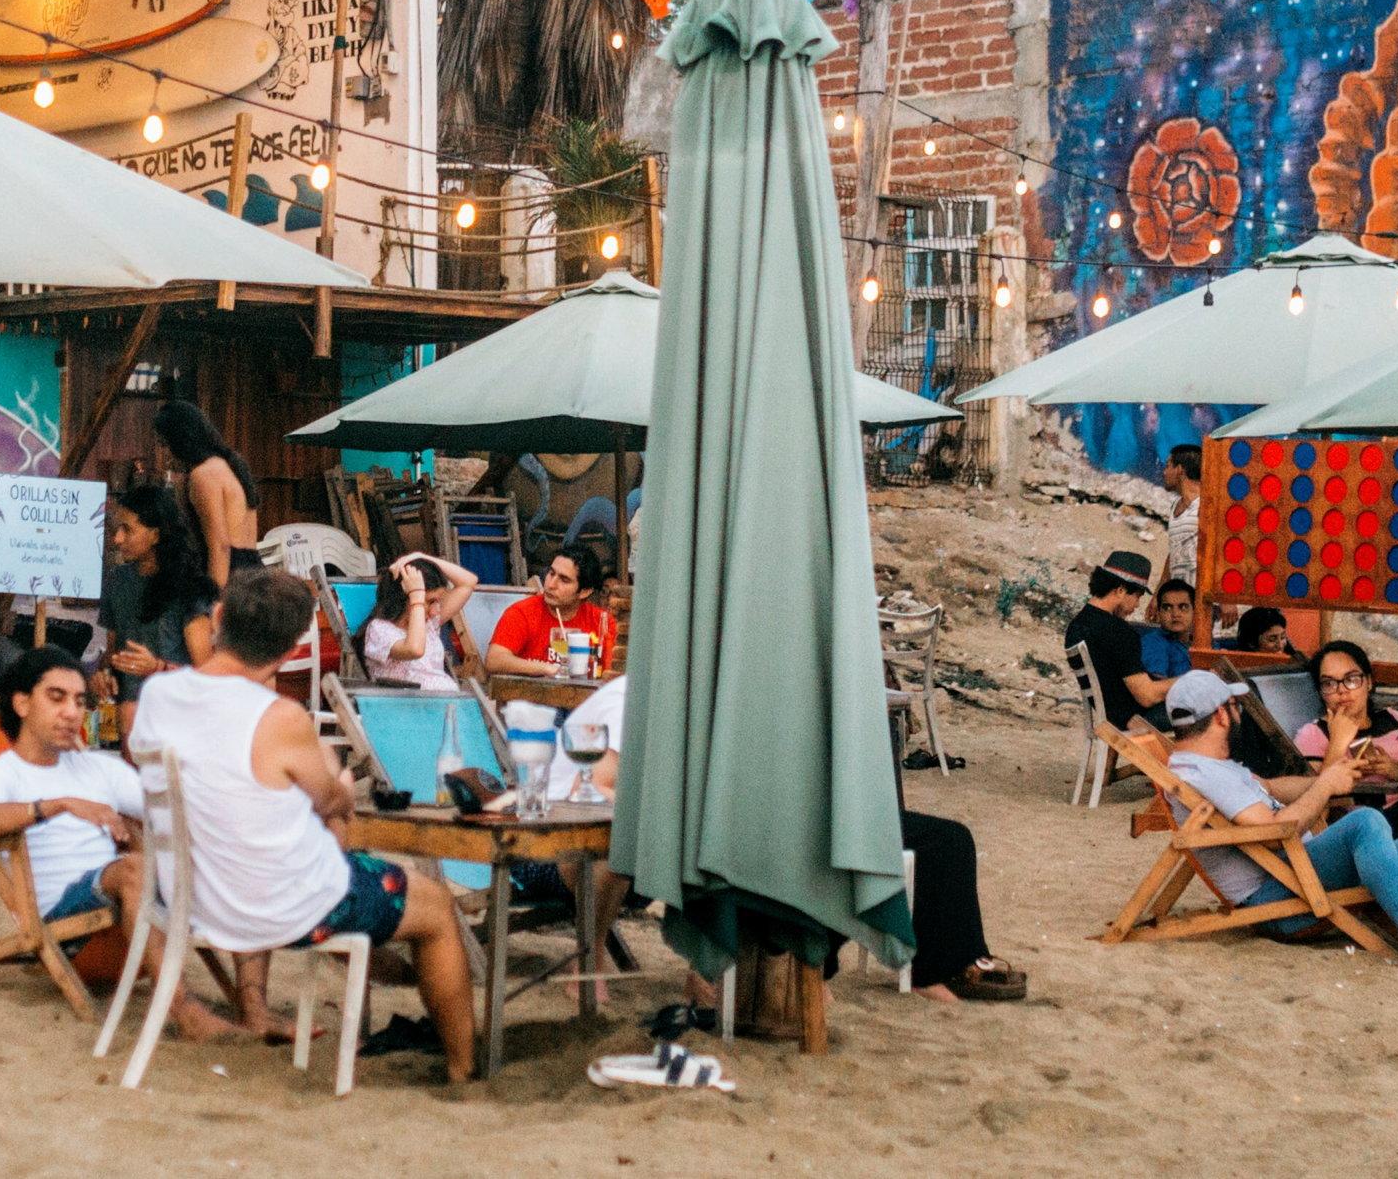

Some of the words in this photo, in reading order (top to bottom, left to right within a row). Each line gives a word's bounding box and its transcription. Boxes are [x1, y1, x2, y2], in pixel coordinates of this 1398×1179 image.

[308, 16, 360, 40] DYY
[309, 40, 362, 64] BEH
[143, 148, 179, 177] QUE
[10, 484, 58, 504] ORILLAS
[61, 489, 80, 505] SIN
[21, 505, 78, 524] COLILLAS
